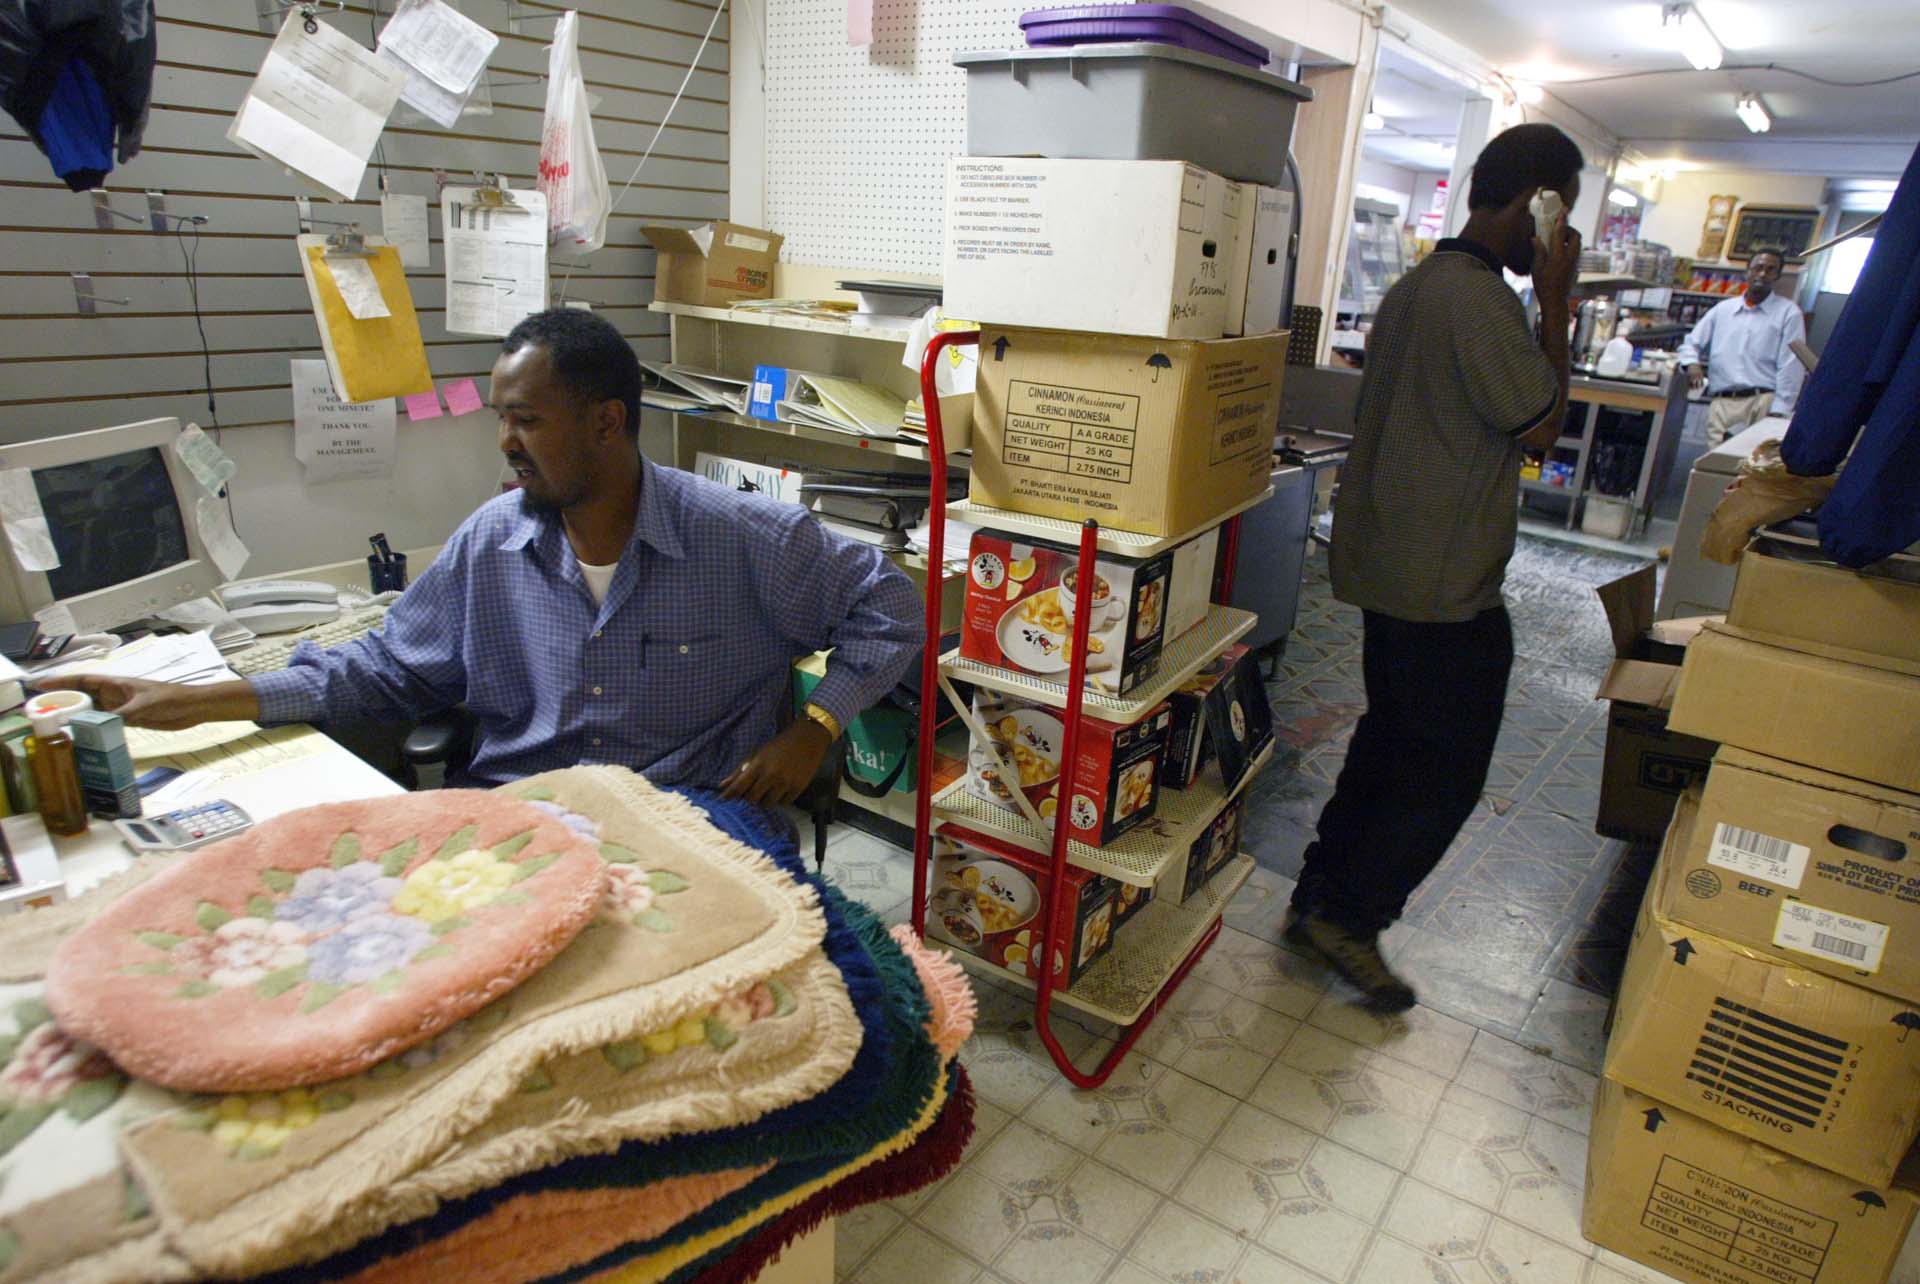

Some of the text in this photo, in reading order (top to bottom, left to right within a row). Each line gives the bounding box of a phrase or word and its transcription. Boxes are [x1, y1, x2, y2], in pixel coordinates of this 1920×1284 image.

[1028, 386, 1075, 402] CINNAMON
[1036, 404, 1111, 423] KERINCI INDONESIA
[1012, 418, 1051, 432] QUALITY
[1010, 435, 1066, 451] NET WEIGHT
[1094, 431, 1129, 444] GRADE
[1009, 453, 1031, 463] ITEM
[1085, 446, 1113, 458] 25 KG
[1076, 463, 1120, 478] 2.75 INCH
[705, 460, 782, 500] ORCA BAY
[1012, 487, 1040, 498] JAKARTA
[1041, 491, 1062, 501] UTARA
[1084, 499, 1118, 511] INDONESIA
[1844, 860, 1904, 882] PRODUCT
[1738, 880, 1775, 897] BEEF
[1864, 875, 1895, 890] MEAT
[1857, 1046, 1864, 1054] 7
[1850, 1060, 1857, 1068] 6
[1844, 1073, 1852, 1082] 5
[1838, 1087, 1846, 1096] 4
[1701, 1089, 1793, 1133] STACKING
[1833, 1100, 1840, 1108] 3
[1827, 1112, 1835, 1121] 2
[1823, 1125, 1829, 1133] 1
[1660, 1191, 1712, 1218] QUALITY
[1650, 1219, 1680, 1236] ITEM
[1657, 1204, 1730, 1240] NET WEIGHT
[1736, 1206, 1794, 1235] INDONESIA
[1756, 1245, 1792, 1266] 25 KG
[1770, 1237, 1816, 1259] GRADE
[1766, 1266, 1798, 1284] INCH
